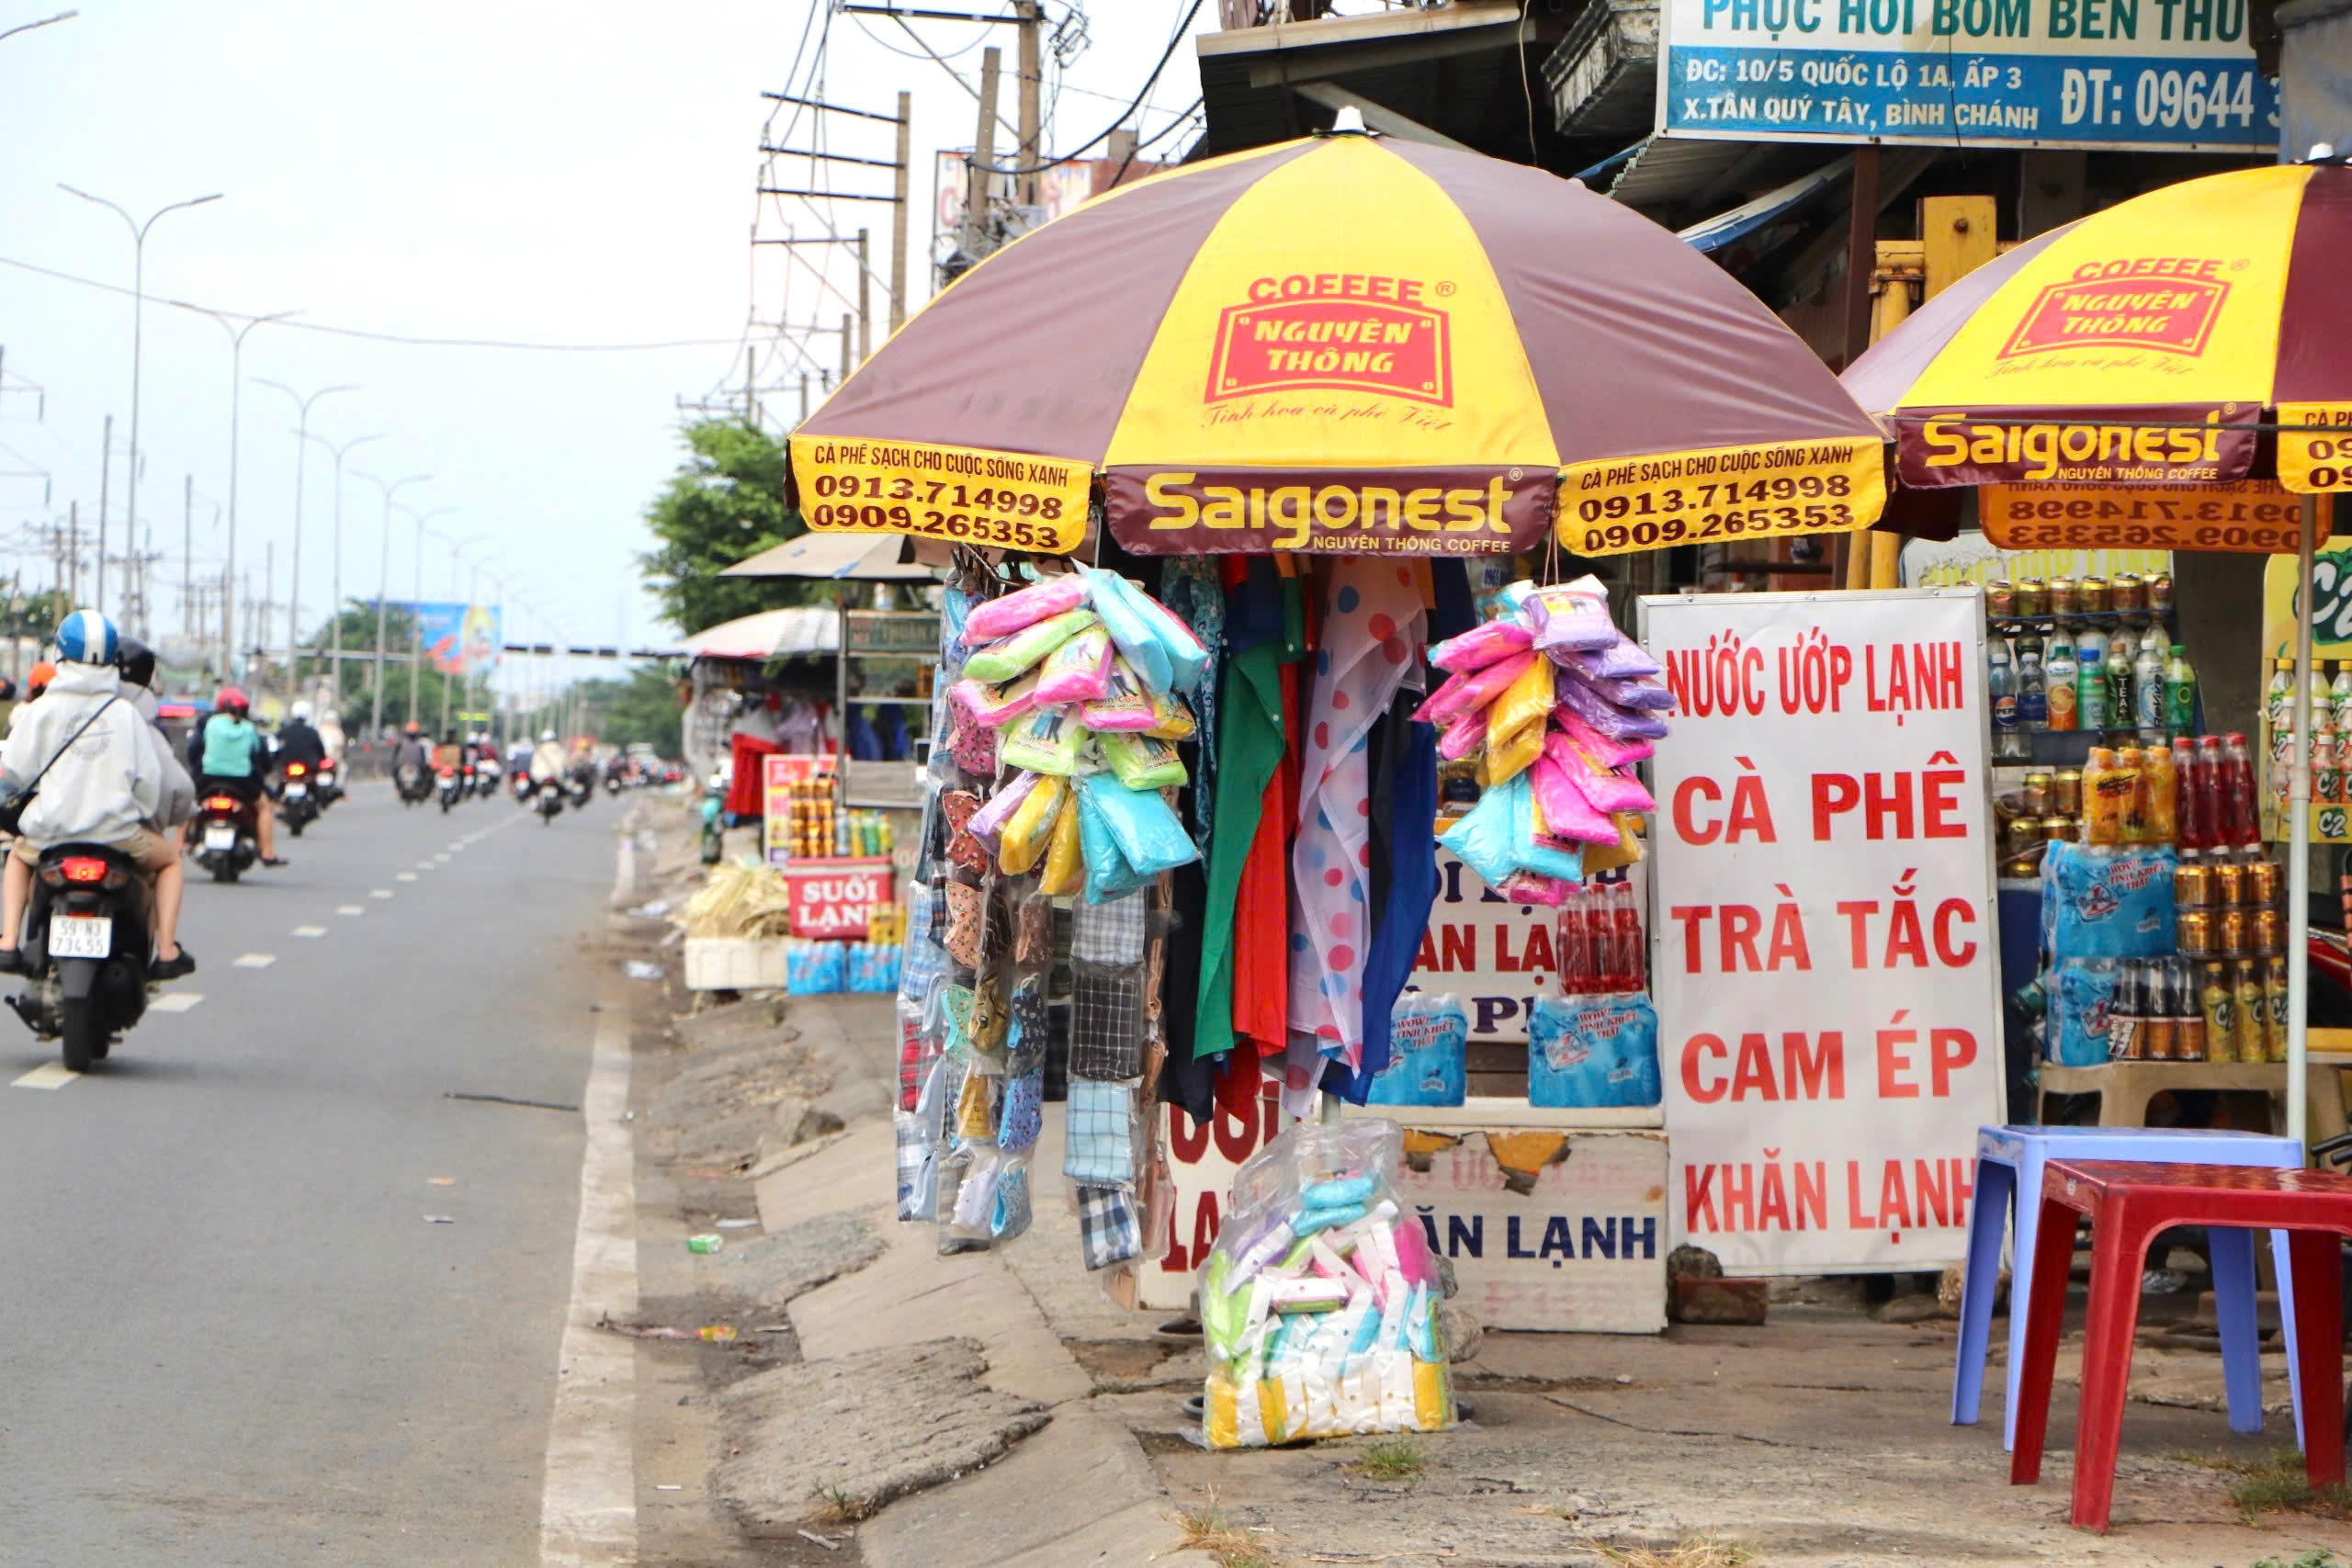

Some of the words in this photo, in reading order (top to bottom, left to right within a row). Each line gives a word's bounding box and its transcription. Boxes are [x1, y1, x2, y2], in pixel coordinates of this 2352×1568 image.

[1703, 0, 1821, 41] PHỤC
[1687, 59, 1725, 81] ĐC:
[1736, 60, 1793, 82] 10/5
[1802, 54, 1868, 86] QUỐC
[1877, 59, 1908, 91] LỘ
[1918, 65, 1956, 91] 1A,
[1963, 57, 1998, 88] ẤP
[2007, 67, 2021, 89] 3
[1764, 95, 1811, 123] QUÝ
[1822, 97, 1877, 130] TÂY,
[1886, 100, 1945, 127] BÌNH
[1954, 99, 2039, 130] CHÁNH
[2061, 69, 2121, 125] ĐT:
[2136, 69, 2254, 130] 09644
[1254, 318, 1413, 344] NGUYÊN
[1267, 347, 1396, 373] THÔNG
[815, 442, 835, 464] CÀ
[840, 444, 866, 465] PHÊ
[872, 447, 910, 469] SẠCH
[914, 450, 942, 471] CHO
[946, 452, 982, 478] CUỘC
[1028, 463, 1069, 488] XANH
[1581, 467, 1601, 490] CÀ
[1605, 461, 1636, 487] PHÊ
[1641, 458, 1682, 482] SẠCH
[1686, 457, 1716, 477] CHO
[1720, 449, 1760, 474] CUỘC
[1809, 446, 1854, 465] XANH
[2058, 466, 2111, 480] NGUYÊN
[2116, 466, 2164, 480] THÔNG
[2167, 468, 2219, 480] COFFEE
[814, 475, 1064, 521] 0913.714998
[1145, 472, 1514, 550] Saigonest
[1578, 474, 1851, 523] 0913.714998
[814, 504, 1060, 549] 0909.265353
[1313, 535, 1380, 549] NGUYÊN
[1386, 535, 1442, 552] THÔNG
[1447, 538, 1512, 553] COFFEE
[1585, 503, 1854, 552] 0909.265353
[1667, 628, 1766, 718] NƯỚC
[1779, 626, 1852, 716] ƯỚP
[1866, 640, 1963, 727] LẠNH
[1672, 756, 1777, 846] CÀ
[1811, 750, 1967, 840] PHÊ
[2319, 811, 2346, 836] C2
[803, 874, 878, 903] SUỐI
[1670, 884, 1812, 974] TRÀ
[1837, 867, 1978, 969] TẮC
[1496, 924, 1557, 986] LẠ
[1680, 1031, 1846, 1104] CAM
[1875, 1010, 1978, 1099] ÉP
[1684, 1147, 1827, 1234] KHĂN
[1847, 1158, 1975, 1245] LẠNH
[1507, 1215, 1657, 1269] LẠNH
